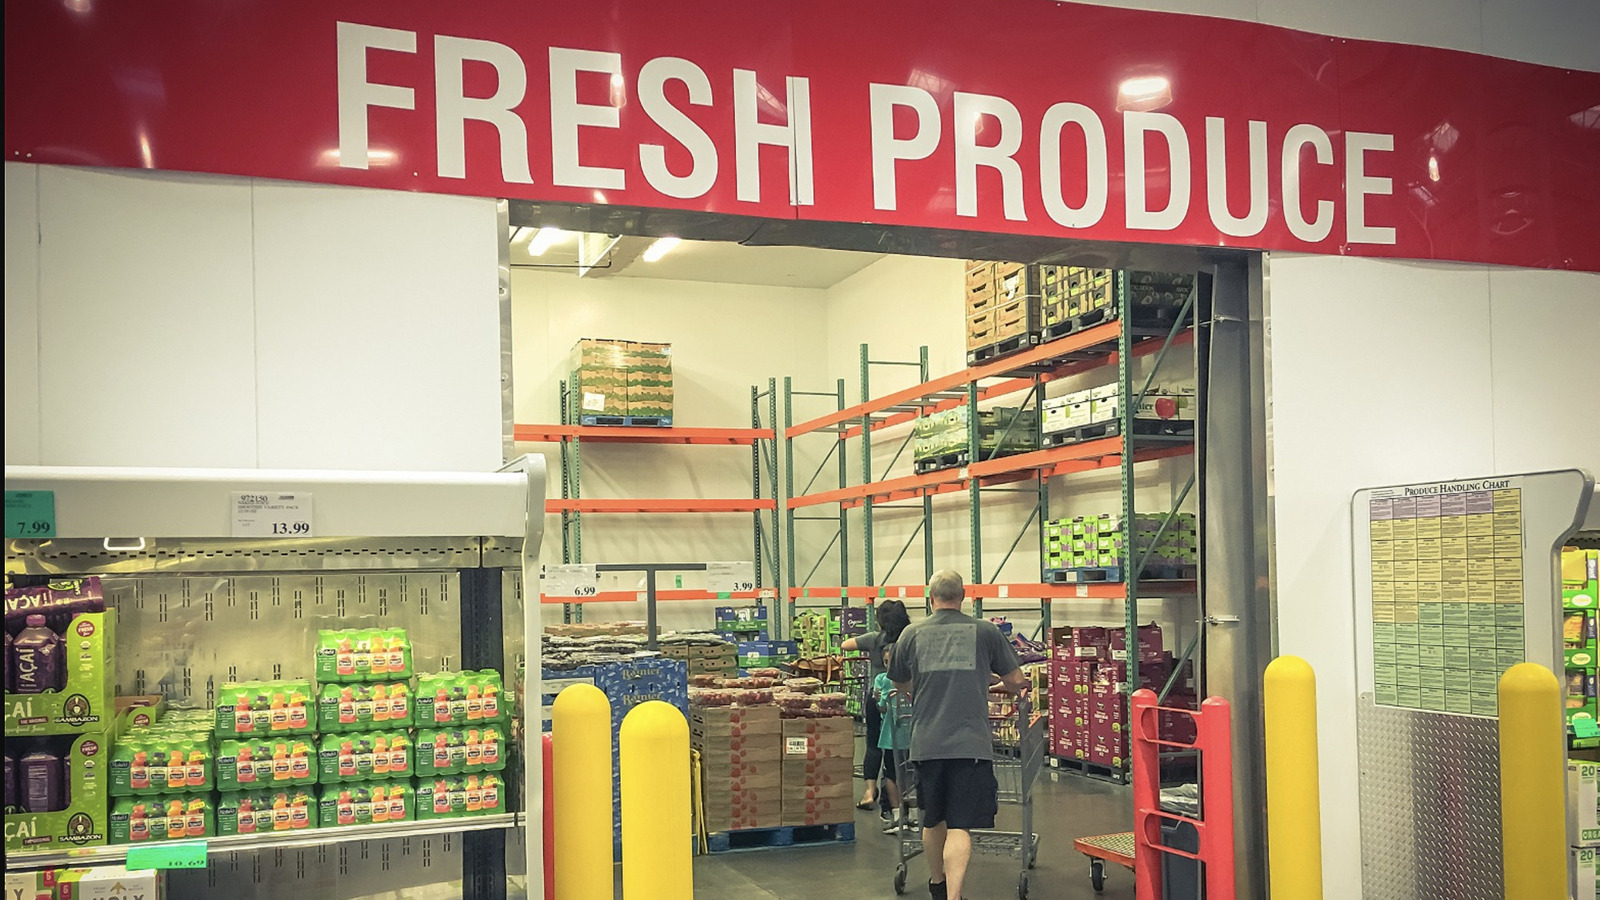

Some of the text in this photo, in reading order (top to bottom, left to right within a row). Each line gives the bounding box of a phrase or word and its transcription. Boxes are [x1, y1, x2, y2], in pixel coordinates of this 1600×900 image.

[336, 20, 1396, 245] FRESH PRODUCE
[1404, 486, 1438, 496] PRODUCE
[1440, 483, 1481, 493] HANDLING
[1482, 480, 1510, 489] CHART
[240, 494, 268, 502] 972150
[17, 522, 51, 534] 7.99
[272, 522, 310, 535] 13.99
[574, 586, 596, 596] 6.99
[733, 582, 753, 591] 3.99
[1581, 765, 1595, 777] 20
[1580, 850, 1593, 861] 20
[45, 872, 52, 881] 6
[63, 885, 69, 894] 6
